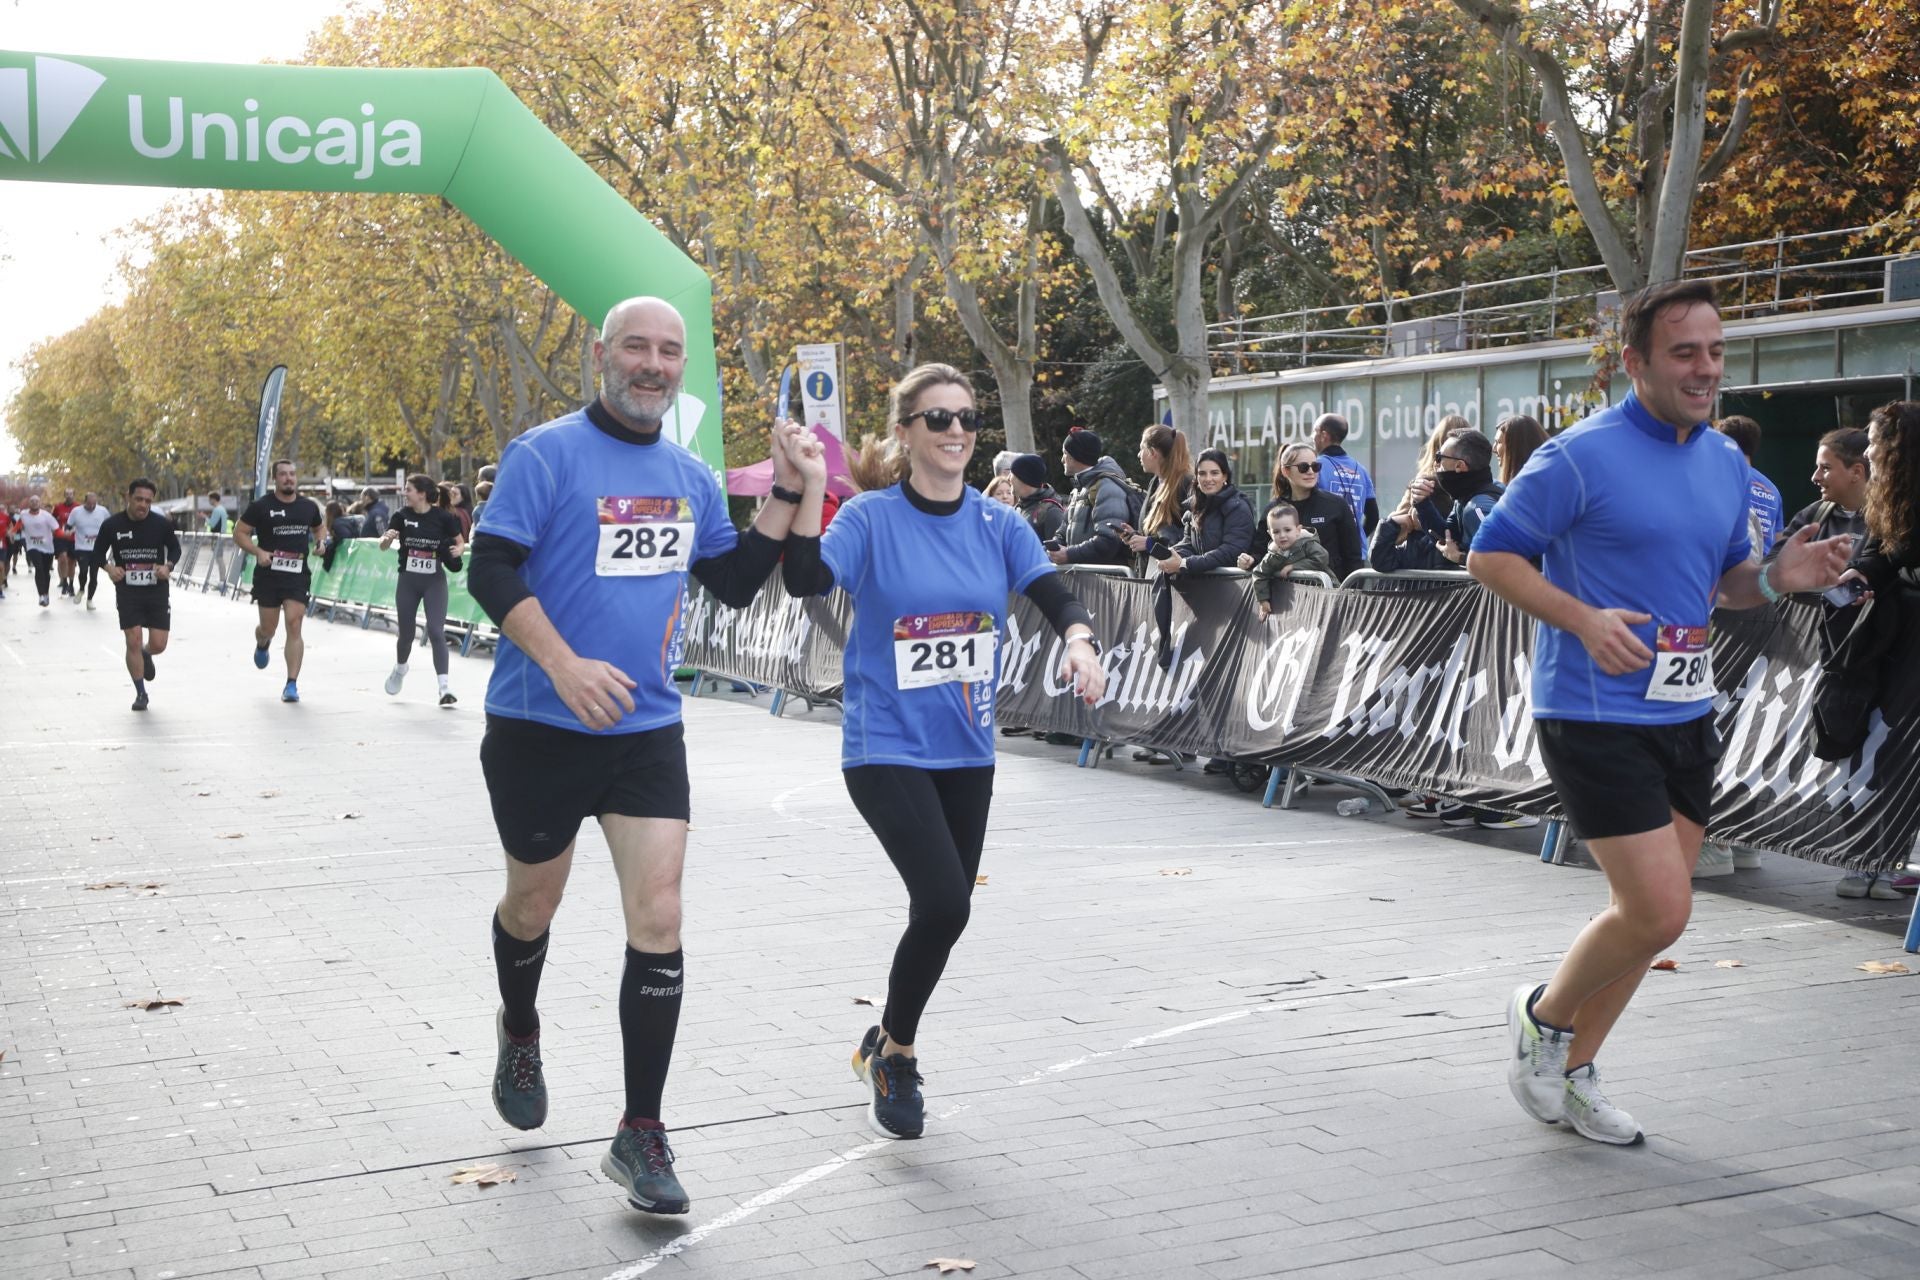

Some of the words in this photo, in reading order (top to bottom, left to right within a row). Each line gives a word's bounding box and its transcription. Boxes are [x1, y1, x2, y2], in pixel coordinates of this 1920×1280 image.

[127, 93, 423, 181] Unicaja
[1208, 399, 1365, 449] ALLADOD
[255, 405, 275, 486] Unicaja
[611, 526, 681, 559] 282
[130, 571, 153, 581] 514
[276, 558, 298, 569] 515
[411, 558, 432, 569] 516
[914, 616, 928, 631] 9ª
[910, 637, 976, 672] 281
[1662, 653, 1709, 687] 280
[1322, 631, 1488, 754] Norte
